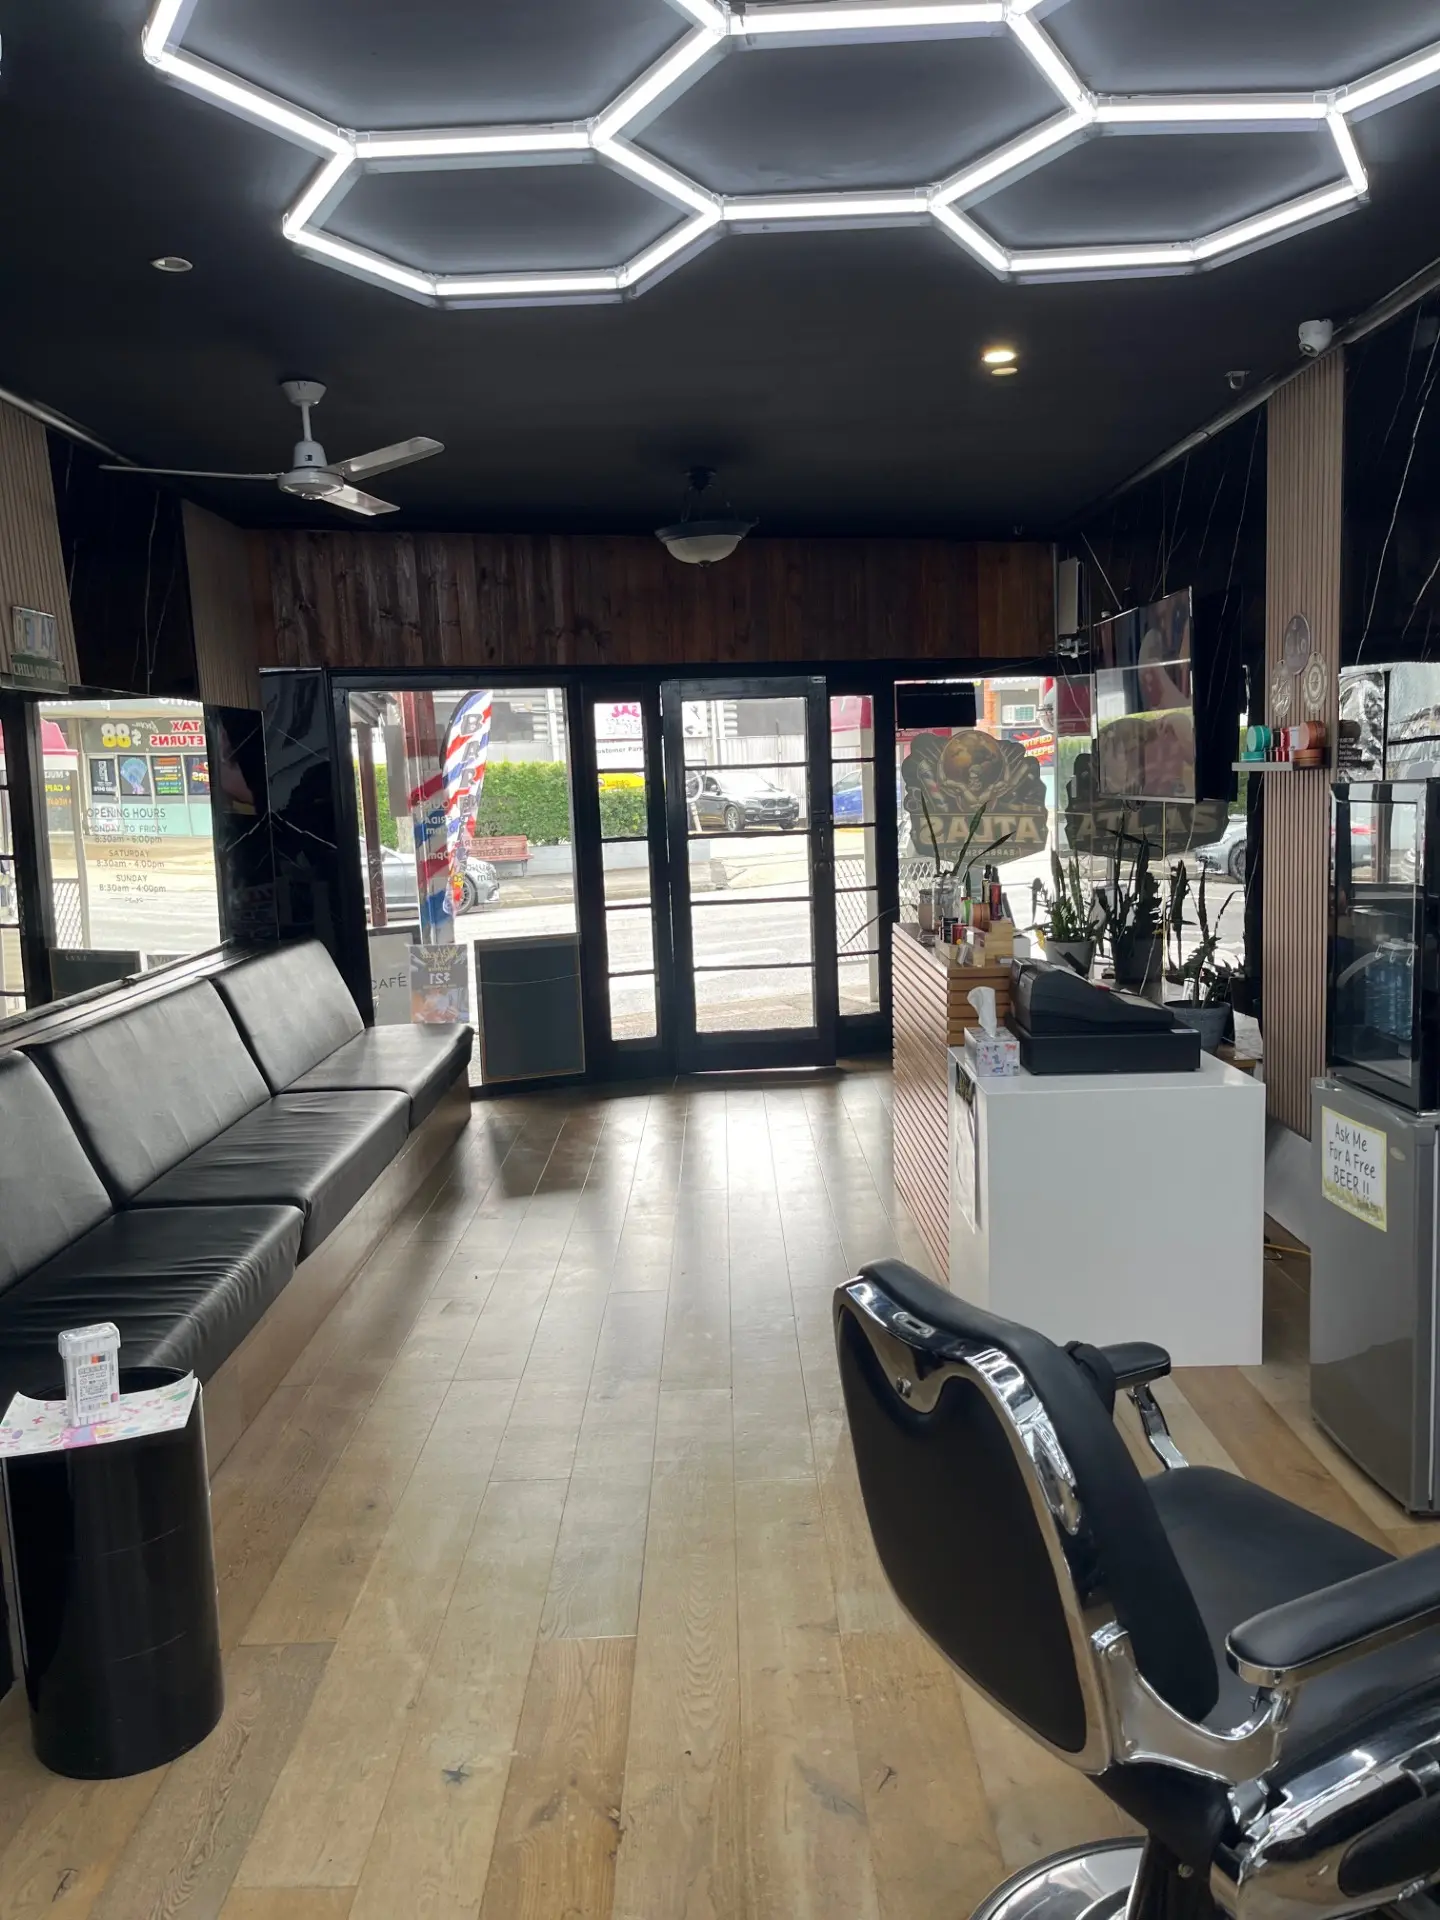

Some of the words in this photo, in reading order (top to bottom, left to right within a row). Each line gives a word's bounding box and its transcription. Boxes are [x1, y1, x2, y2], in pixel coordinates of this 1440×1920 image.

[87, 808, 130, 818] OPENING
[132, 808, 166, 818] HOURS
[90, 825, 120, 833] MONDAY
[124, 825, 136, 833] TO
[139, 825, 168, 833] FRIDAY
[96, 860, 127, 868] 8:30am
[99, 884, 130, 892] 8:30am
[1335, 1121, 1350, 1145] Ask
[1353, 1129, 1368, 1152] Me
[1329, 1140, 1342, 1161] For
[1345, 1149, 1352, 1167] A
[1353, 1153, 1376, 1179] Free
[1333, 1165, 1359, 1196] BEER
